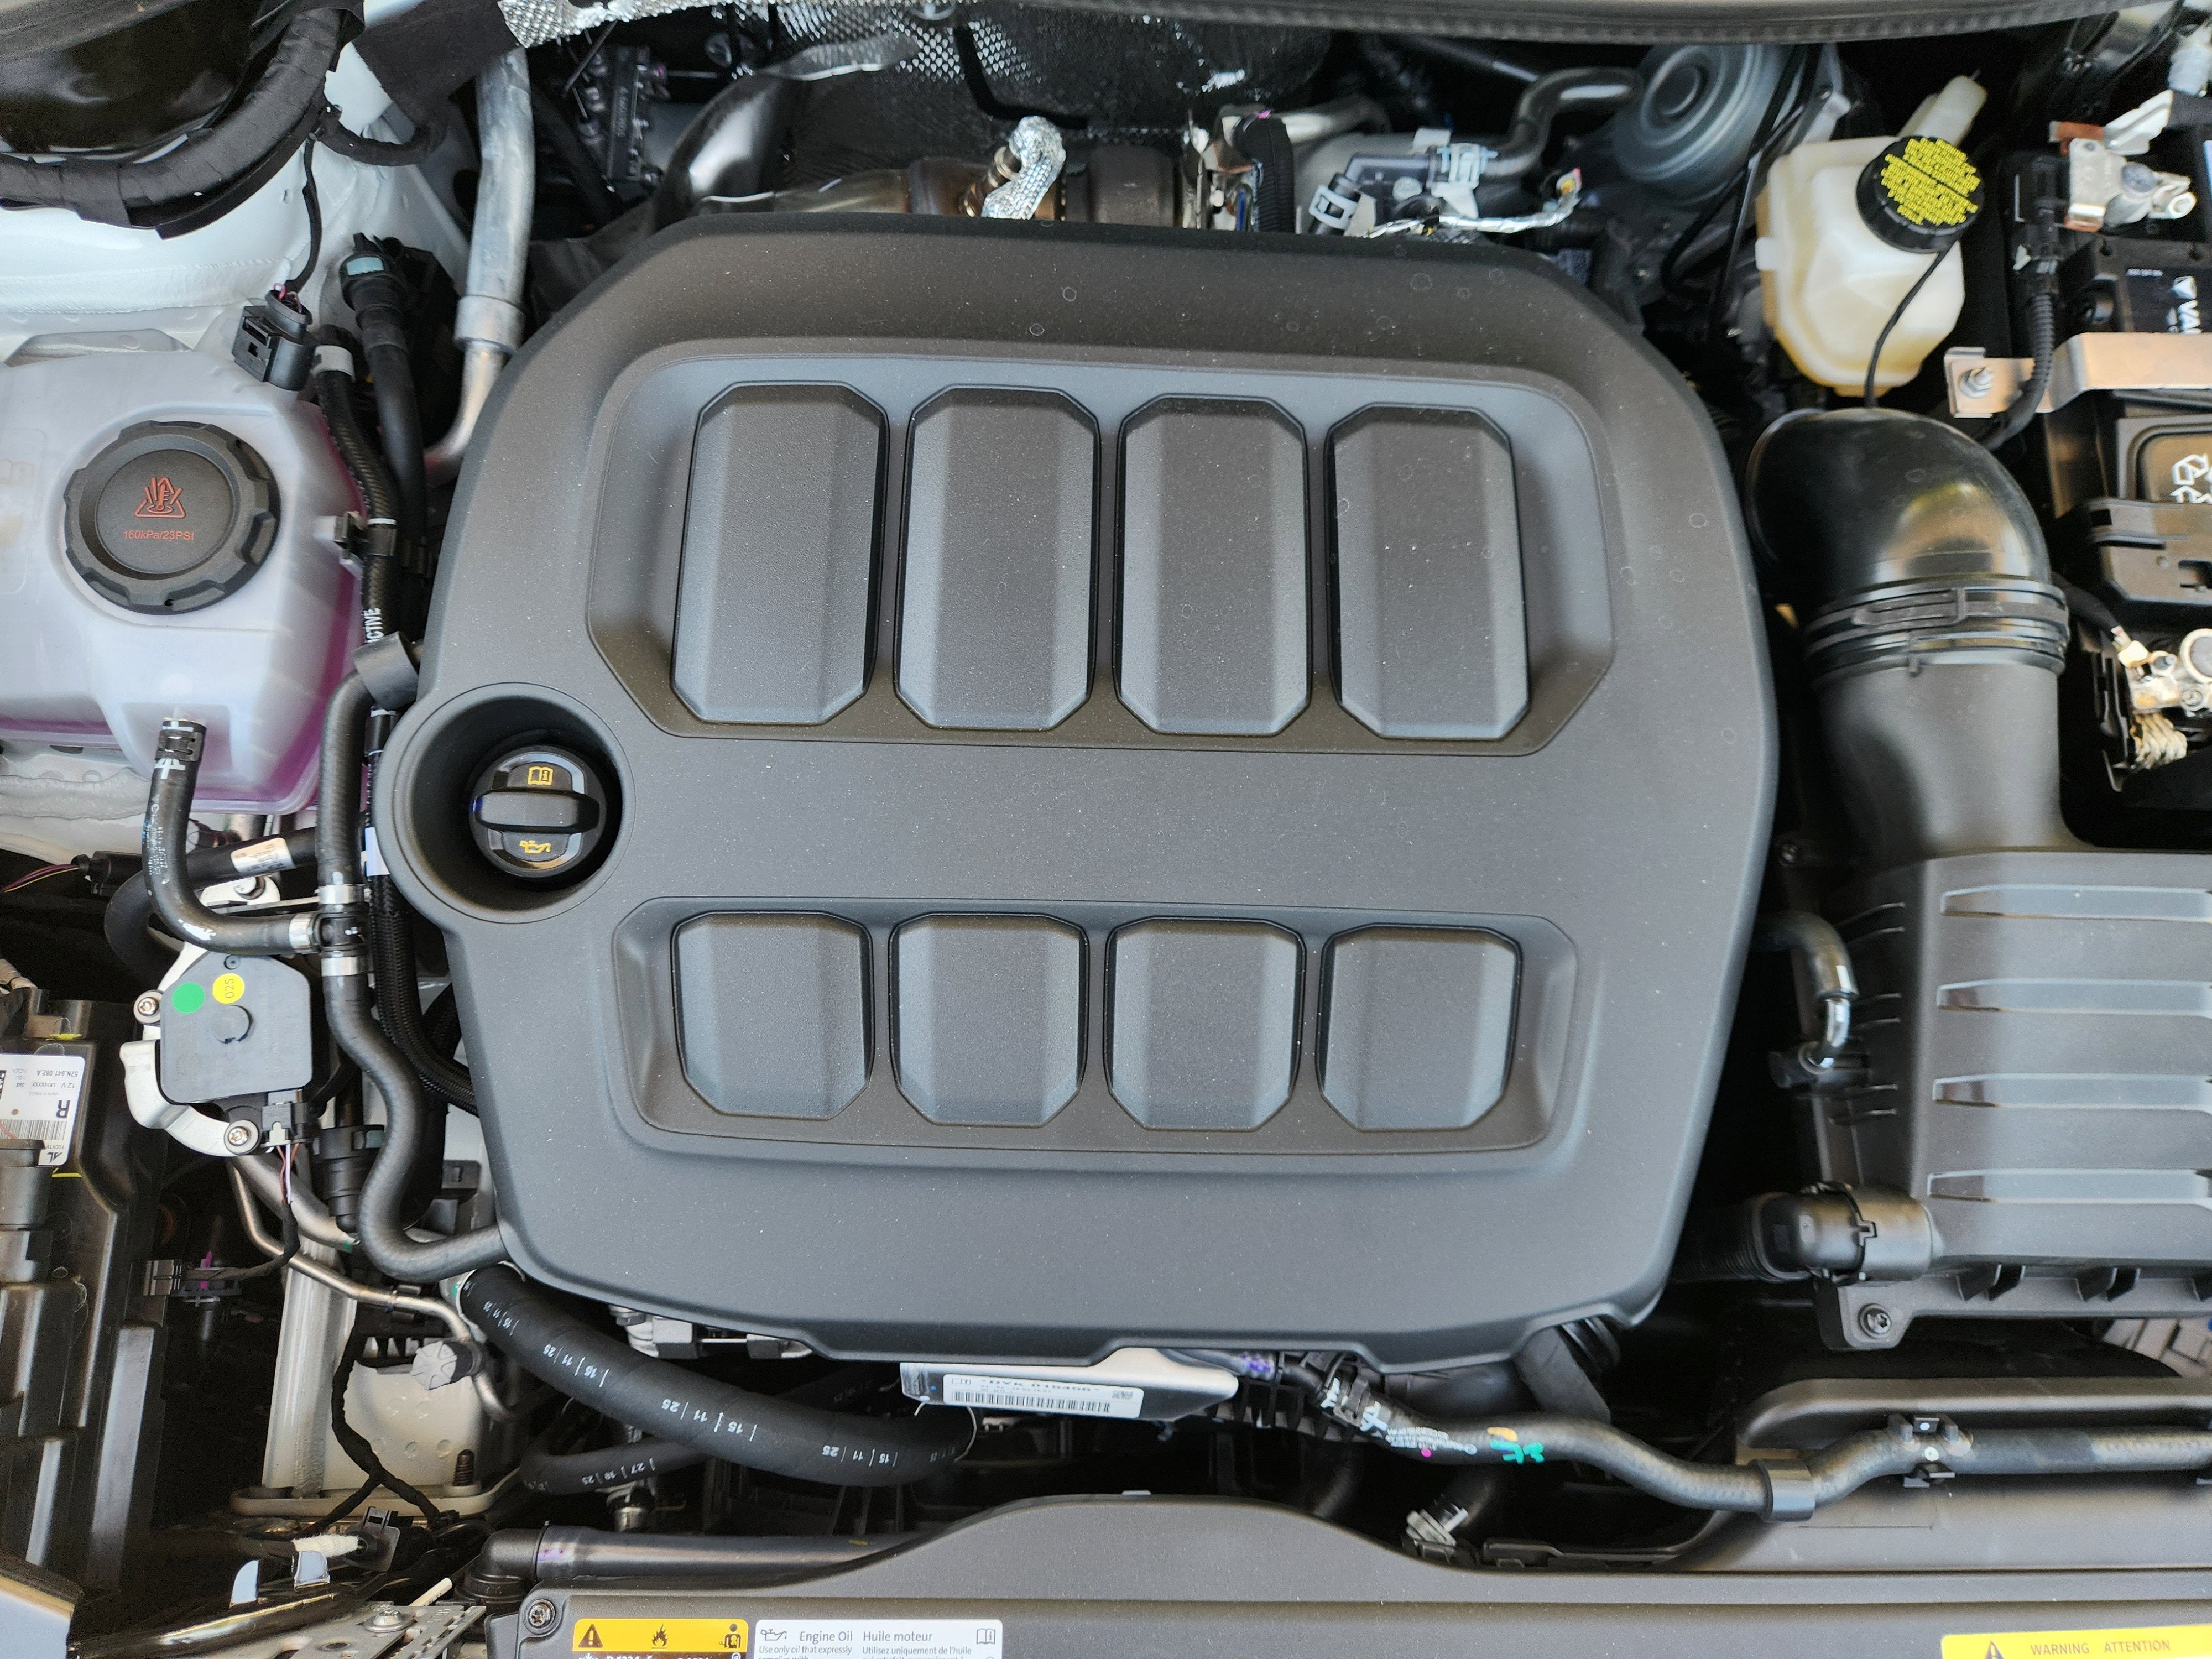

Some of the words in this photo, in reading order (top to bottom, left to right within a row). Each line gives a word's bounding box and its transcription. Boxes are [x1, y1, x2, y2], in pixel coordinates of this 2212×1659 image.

[2177, 299, 2202, 335] VA
[123, 530, 195, 540] 160kPa/23PSI
[56, 1099, 71, 1119] R
[661, 1399, 681, 1413] 25
[693, 1410, 708, 1422] 11
[727, 1421, 744, 1434] 15
[800, 1631, 835, 1645] Engine
[838, 1630, 853, 1642] Oil
[863, 1631, 891, 1642] Huile
[894, 1632, 933, 1642] moteur
[759, 1645, 773, 1653] Use
[774, 1645, 790, 1655] only
[791, 1645, 800, 1653] oil
[802, 1645, 817, 1653] that
[818, 1645, 852, 1655] expressly
[862, 1646, 890, 1655] Utilisez
[891, 1646, 936, 1656] uniquement
[938, 1646, 948, 1655] de
[949, 1646, 972, 1655] l'huile
[2030, 1642, 2090, 1656] WARNING
[2104, 1639, 2171, 1653] ATTENTION
